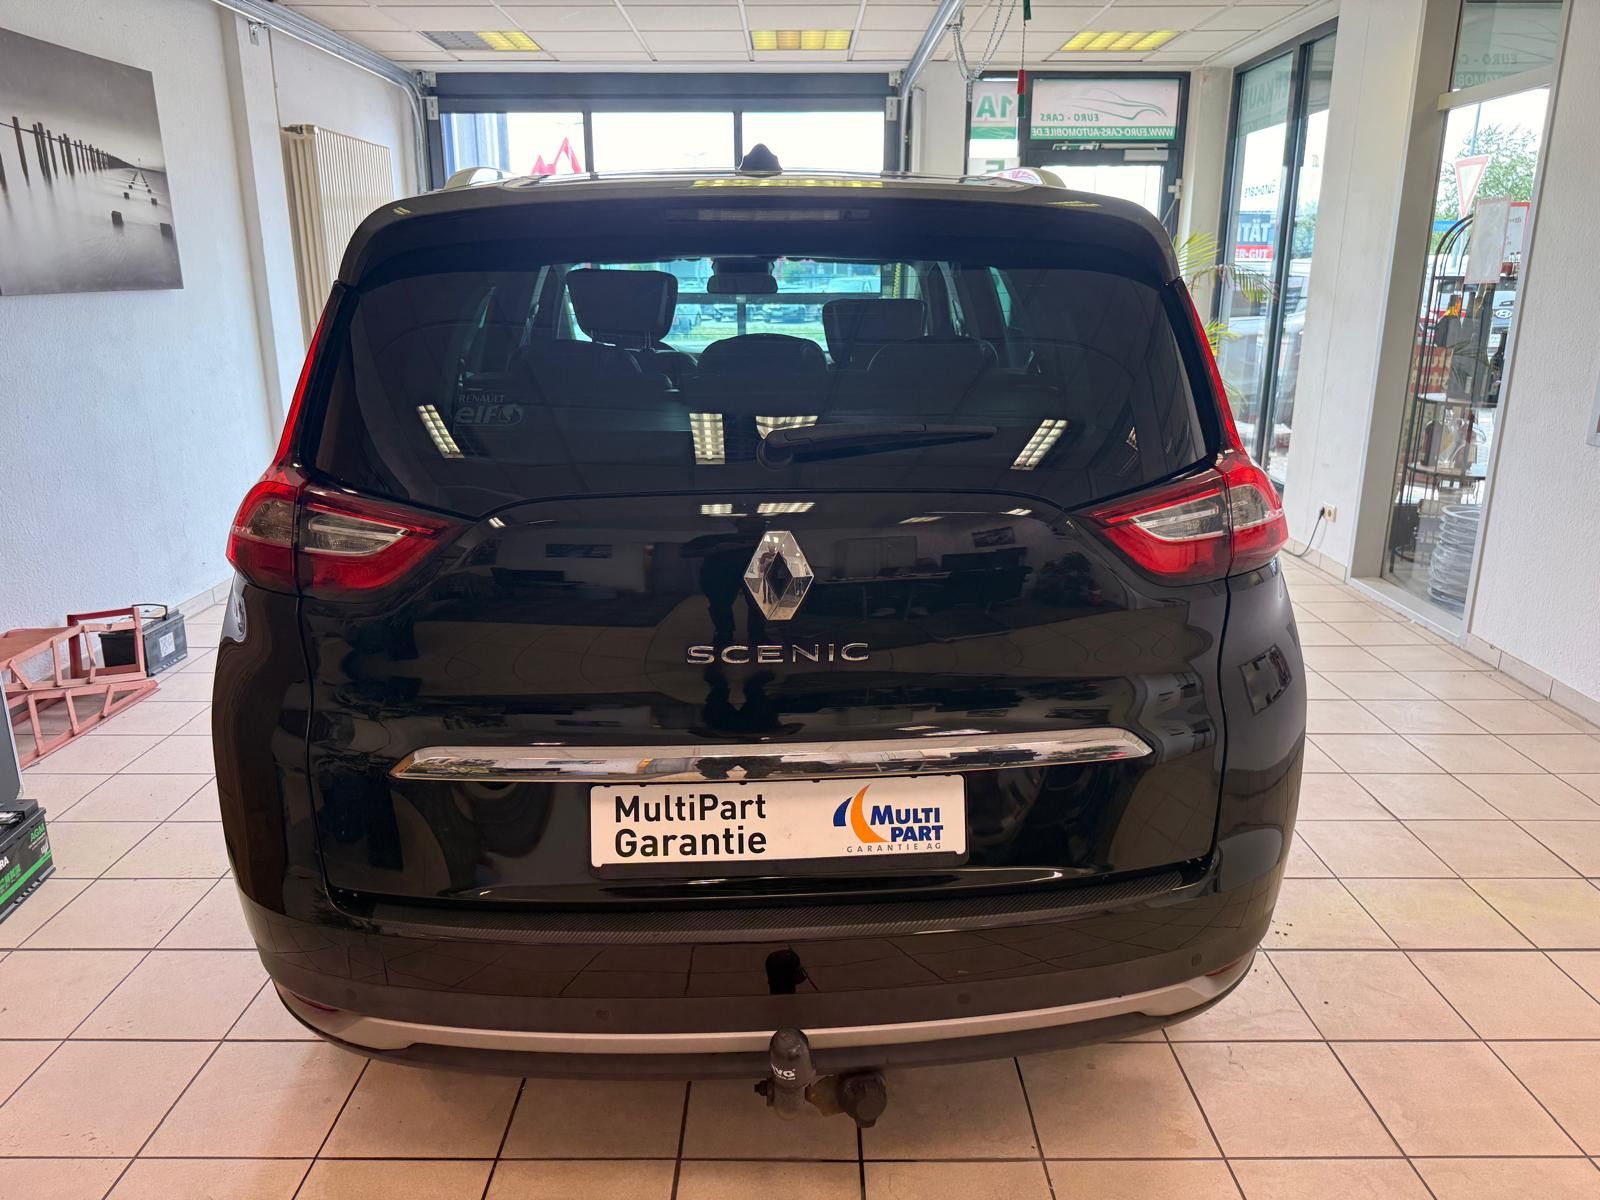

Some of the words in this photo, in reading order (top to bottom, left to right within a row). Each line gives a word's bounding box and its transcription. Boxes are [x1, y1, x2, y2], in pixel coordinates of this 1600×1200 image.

[458, 392, 504, 403] RENAULT
[687, 642, 870, 664] SCENIC
[615, 794, 767, 823] MultiPart
[30, 822, 46, 842] AGM
[615, 825, 767, 858] Garantie
[890, 825, 944, 843] PART
[846, 842, 918, 853] GARANTIE
[926, 842, 941, 850] AG
